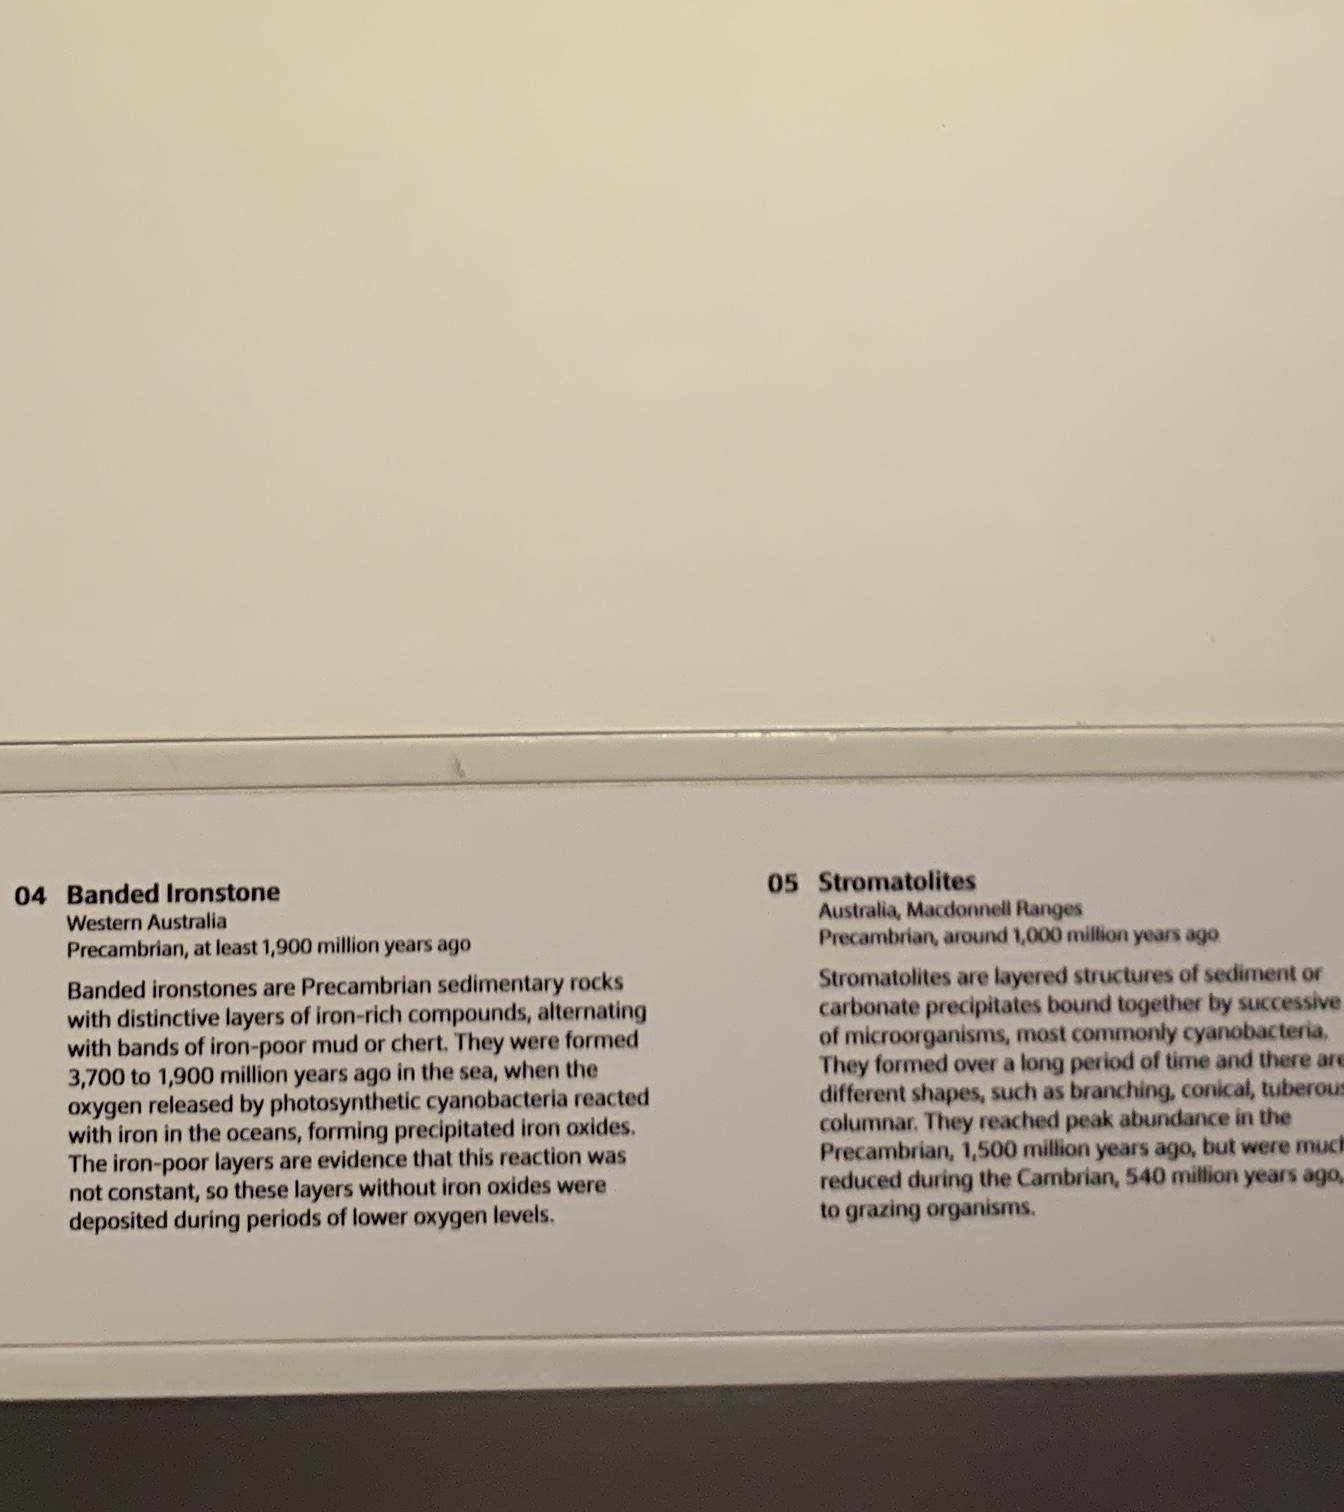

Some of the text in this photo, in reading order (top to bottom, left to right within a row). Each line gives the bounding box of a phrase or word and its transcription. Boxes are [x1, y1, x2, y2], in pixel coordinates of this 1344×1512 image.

[14, 881, 280, 906] 04 Banded Ironstone
[767, 868, 976, 894] 05 Stromatolites
[66, 911, 227, 932] Western Australia
[818, 898, 1083, 922] Australia, Macdonnell Ranges
[67, 935, 471, 961] Precambrian, at least 1,900 million years ago
[819, 925, 1219, 948] Precambrian, around 1,000 million years ago
[67, 971, 623, 1000] Banded ironstones are Precambrian sedimentary rocks
[819, 962, 1322, 991] Stromatolites are layered structures of sediment or
[67, 999, 646, 1031] with distinctive layers of iron-rich compounds, alternating
[819, 995, 920, 1018] carbonate
[925, 994, 1042, 1021] precipitates
[1047, 993, 1112, 1015] bound
[1117, 993, 1202, 1018] together
[1208, 992, 1232, 1017] by
[1238, 991, 1341, 1012] successive
[67, 1029, 638, 1061] with bands of iron-poor mud or chert. They were formed
[819, 1020, 1328, 1051] of microorganisms, most commonly cyanobacteria.
[68, 1058, 598, 1090] 3,700 to 1,900 million years ago in the sea, when the
[818, 1054, 869, 1080] They
[874, 1052, 948, 1074] formed
[953, 1057, 998, 1074] over
[1003, 1056, 1015, 1073] a
[1020, 1051, 1064, 1077] long
[1070, 1050, 1134, 1076] period
[1140, 1050, 1160, 1071] of
[1165, 1050, 1210, 1071] time
[1215, 1048, 1253, 1071] and
[1259, 1049, 1311, 1070] there
[67, 1087, 649, 1121] oxygen released by photosynthetic cyanobacteria reacted
[819, 1082, 906, 1104] different
[911, 1081, 985, 1107] shapes,
[991, 1080, 1037, 1102] such
[1042, 1085, 1064, 1101] as
[1070, 1079, 1175, 1105] branching,
[1181, 1077, 1255, 1101] conical,
[68, 1116, 635, 1146] with iron in the oceans, forming precipitated iron oxides.
[819, 1106, 1291, 1136] columnar. They reached peak abundance in the
[68, 1145, 626, 1177] The iron-poor layers are evidence that this reaction was
[820, 1139, 954, 1164] Precambrian,
[961, 1139, 1017, 1162] 1,500
[1023, 1137, 1090, 1158] million
[1095, 1141, 1149, 1162] years
[1154, 1140, 1196, 1162] ago,
[1202, 1135, 1236, 1156] but
[1240, 1139, 1290, 1156] were
[69, 1175, 606, 1204] not constant, so these layers without iron oxides were
[820, 1169, 902, 1191] reduced
[907, 1168, 973, 1194] during
[979, 1167, 1012, 1189] the
[1016, 1166, 1119, 1190] Cambrian,
[1125, 1166, 1166, 1186] 540
[1171, 1164, 1238, 1185] million
[1243, 1168, 1297, 1189] years
[1302, 1167, 1344, 1188] ago,
[69, 1203, 554, 1235] deposited during periods of lower oxygen levels.
[820, 1197, 1035, 1224] to grazing organisms.
